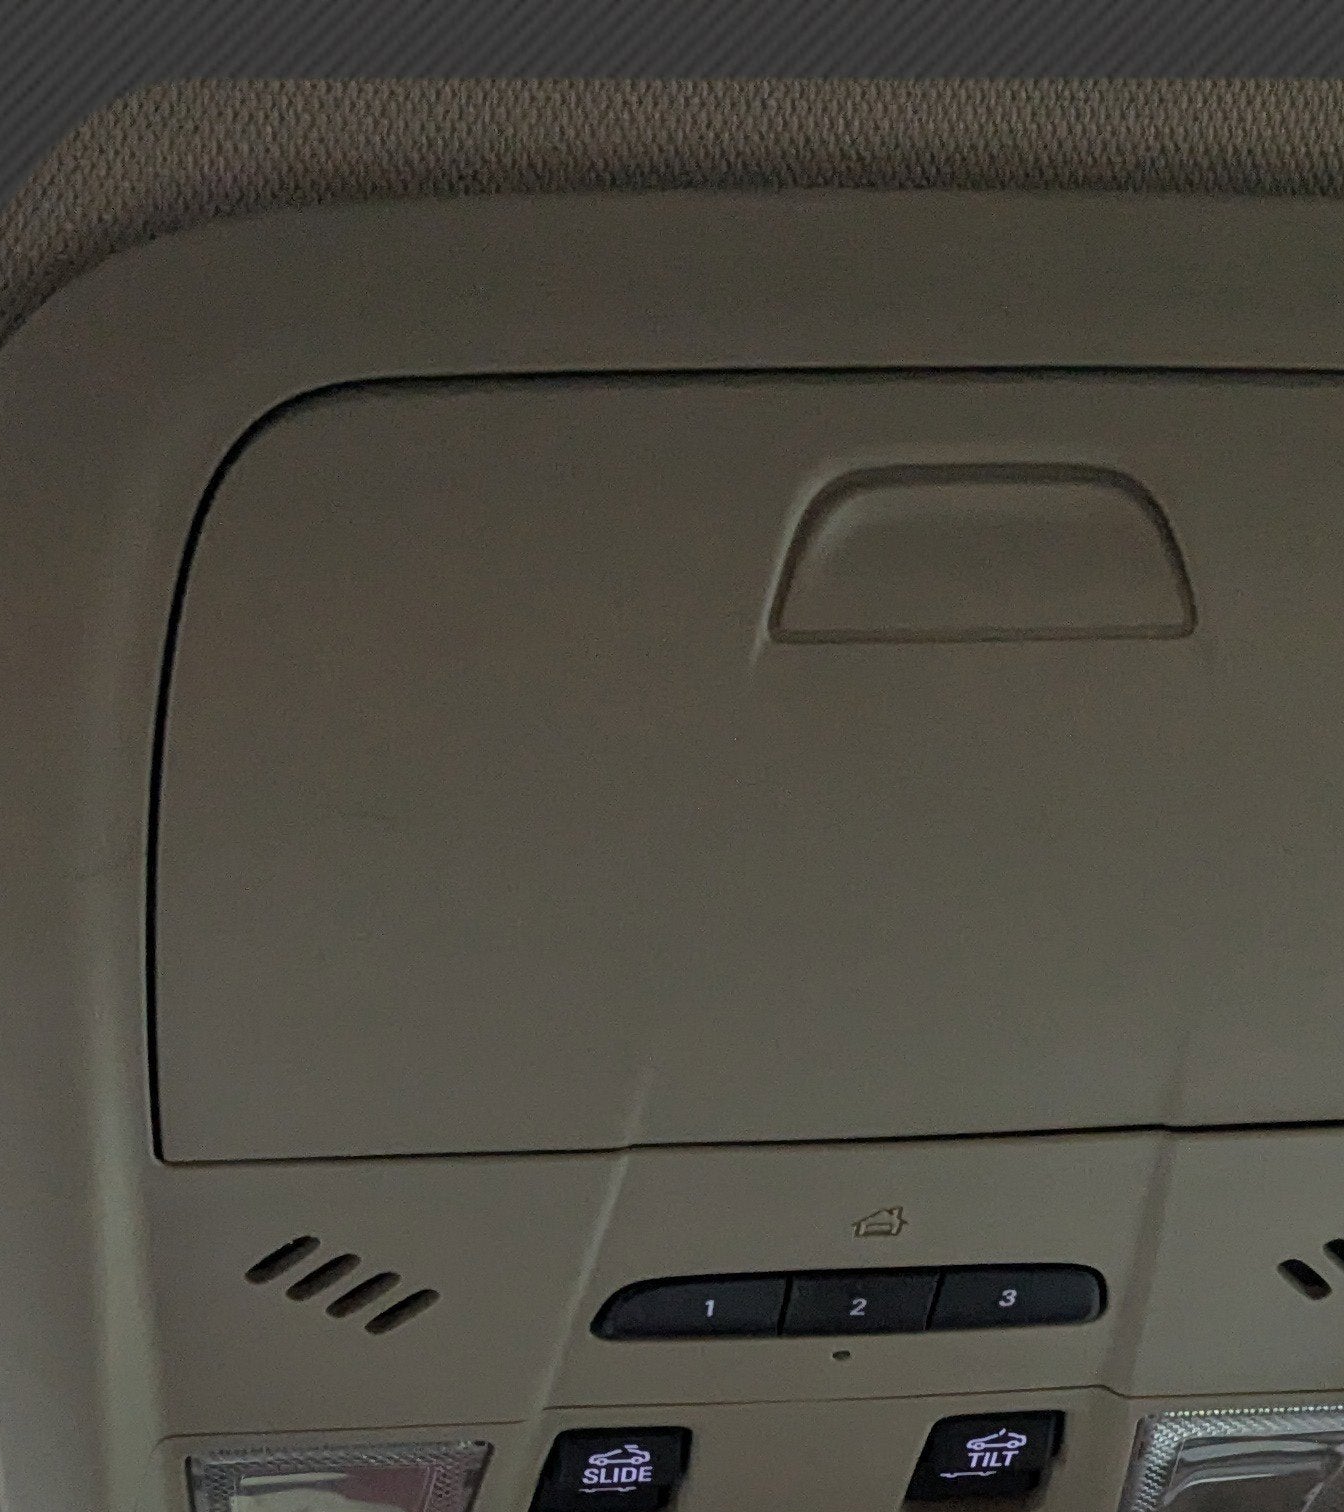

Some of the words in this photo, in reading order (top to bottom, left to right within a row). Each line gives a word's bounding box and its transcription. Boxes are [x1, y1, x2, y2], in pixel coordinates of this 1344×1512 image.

[849, 1297, 868, 1317] 2
[998, 1289, 1018, 1308] 3
[704, 1299, 716, 1318] 1
[967, 1450, 1020, 1469] TILT
[582, 1466, 654, 1485] SLIDE
